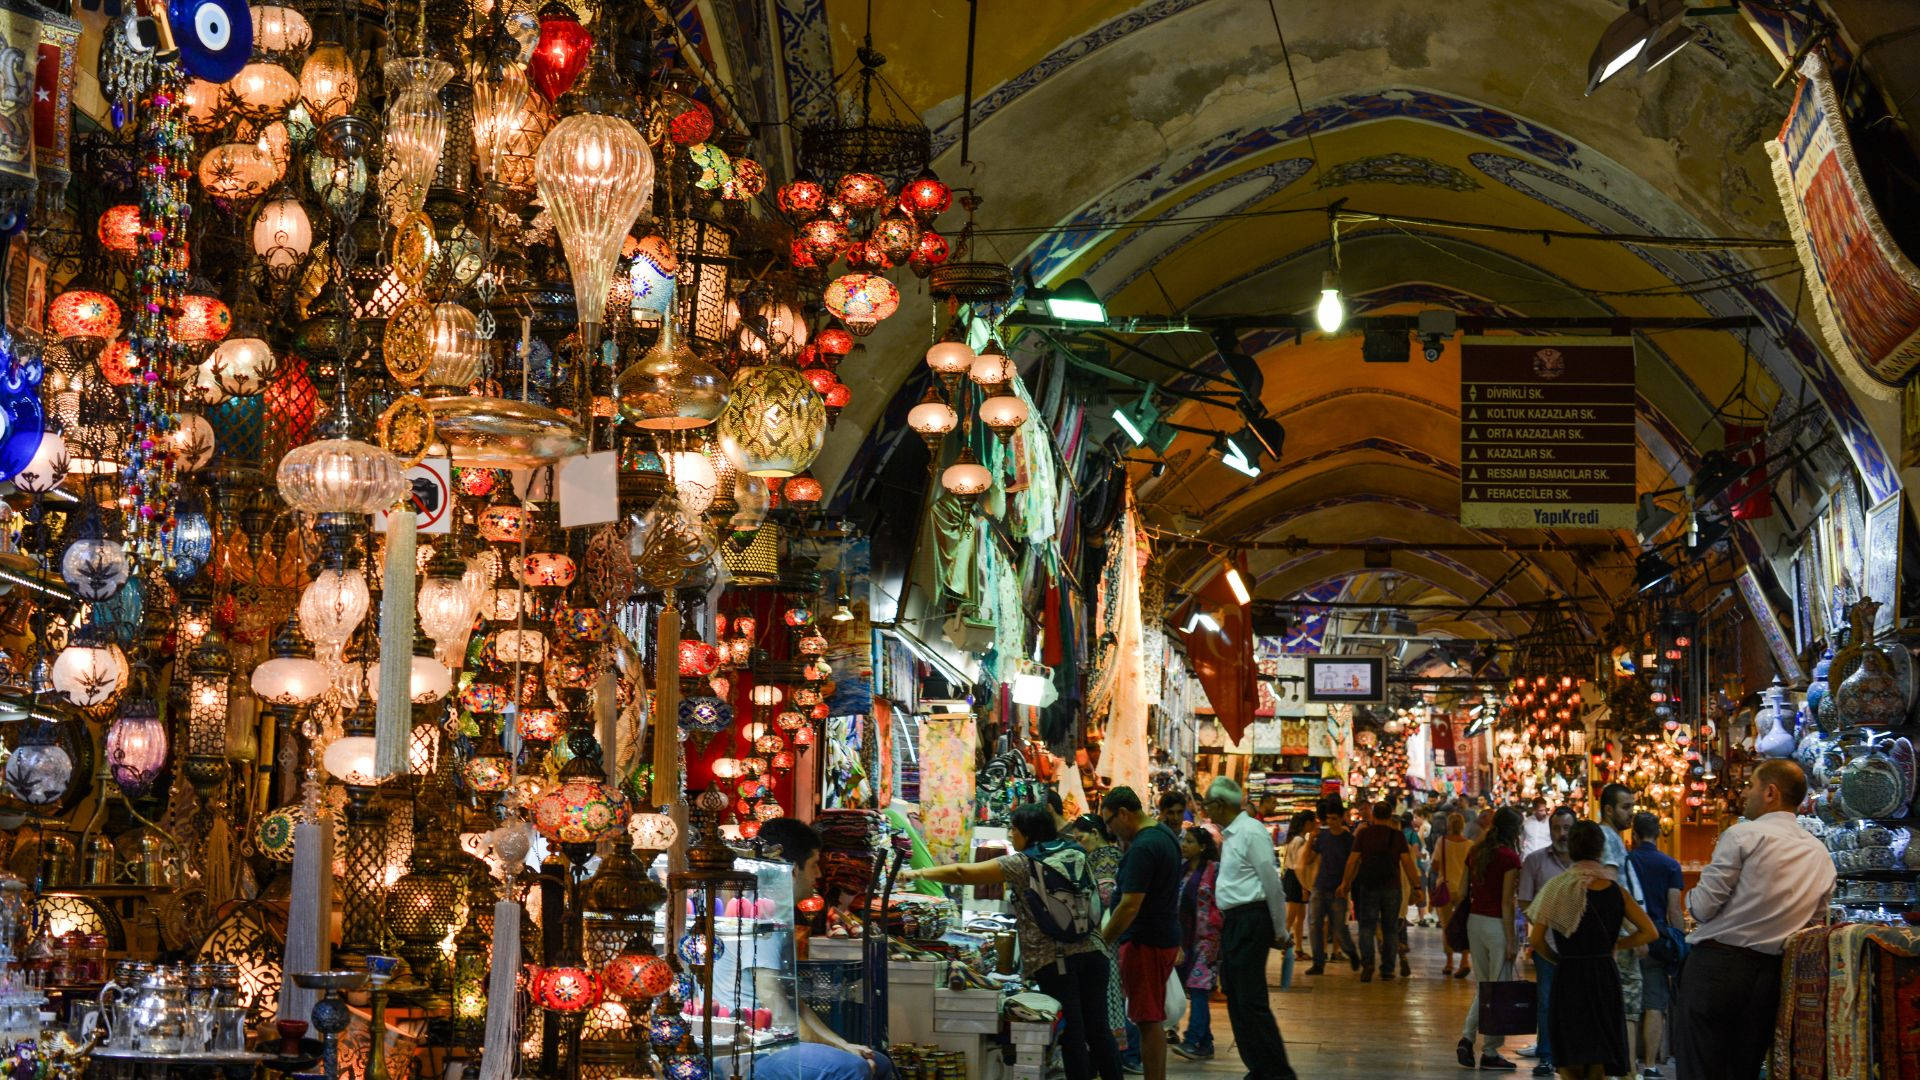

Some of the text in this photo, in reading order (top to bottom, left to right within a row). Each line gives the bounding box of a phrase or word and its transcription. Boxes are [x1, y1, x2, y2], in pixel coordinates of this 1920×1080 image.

[1487, 386, 1544, 399] DİVRİKLİ SK.
[1487, 409, 1596, 419] KOLTUK KAZAZLAR SK.
[1487, 429, 1584, 439] ORTA KAZAZLAR SK.
[1487, 449, 1555, 459] KAZAZLAR SK.
[1487, 469, 1609, 479] RESSAM BASMACILAR SK.
[1487, 487, 1571, 499] FERACECİLER SK.
[1534, 509, 1599, 525] YapıKredi
